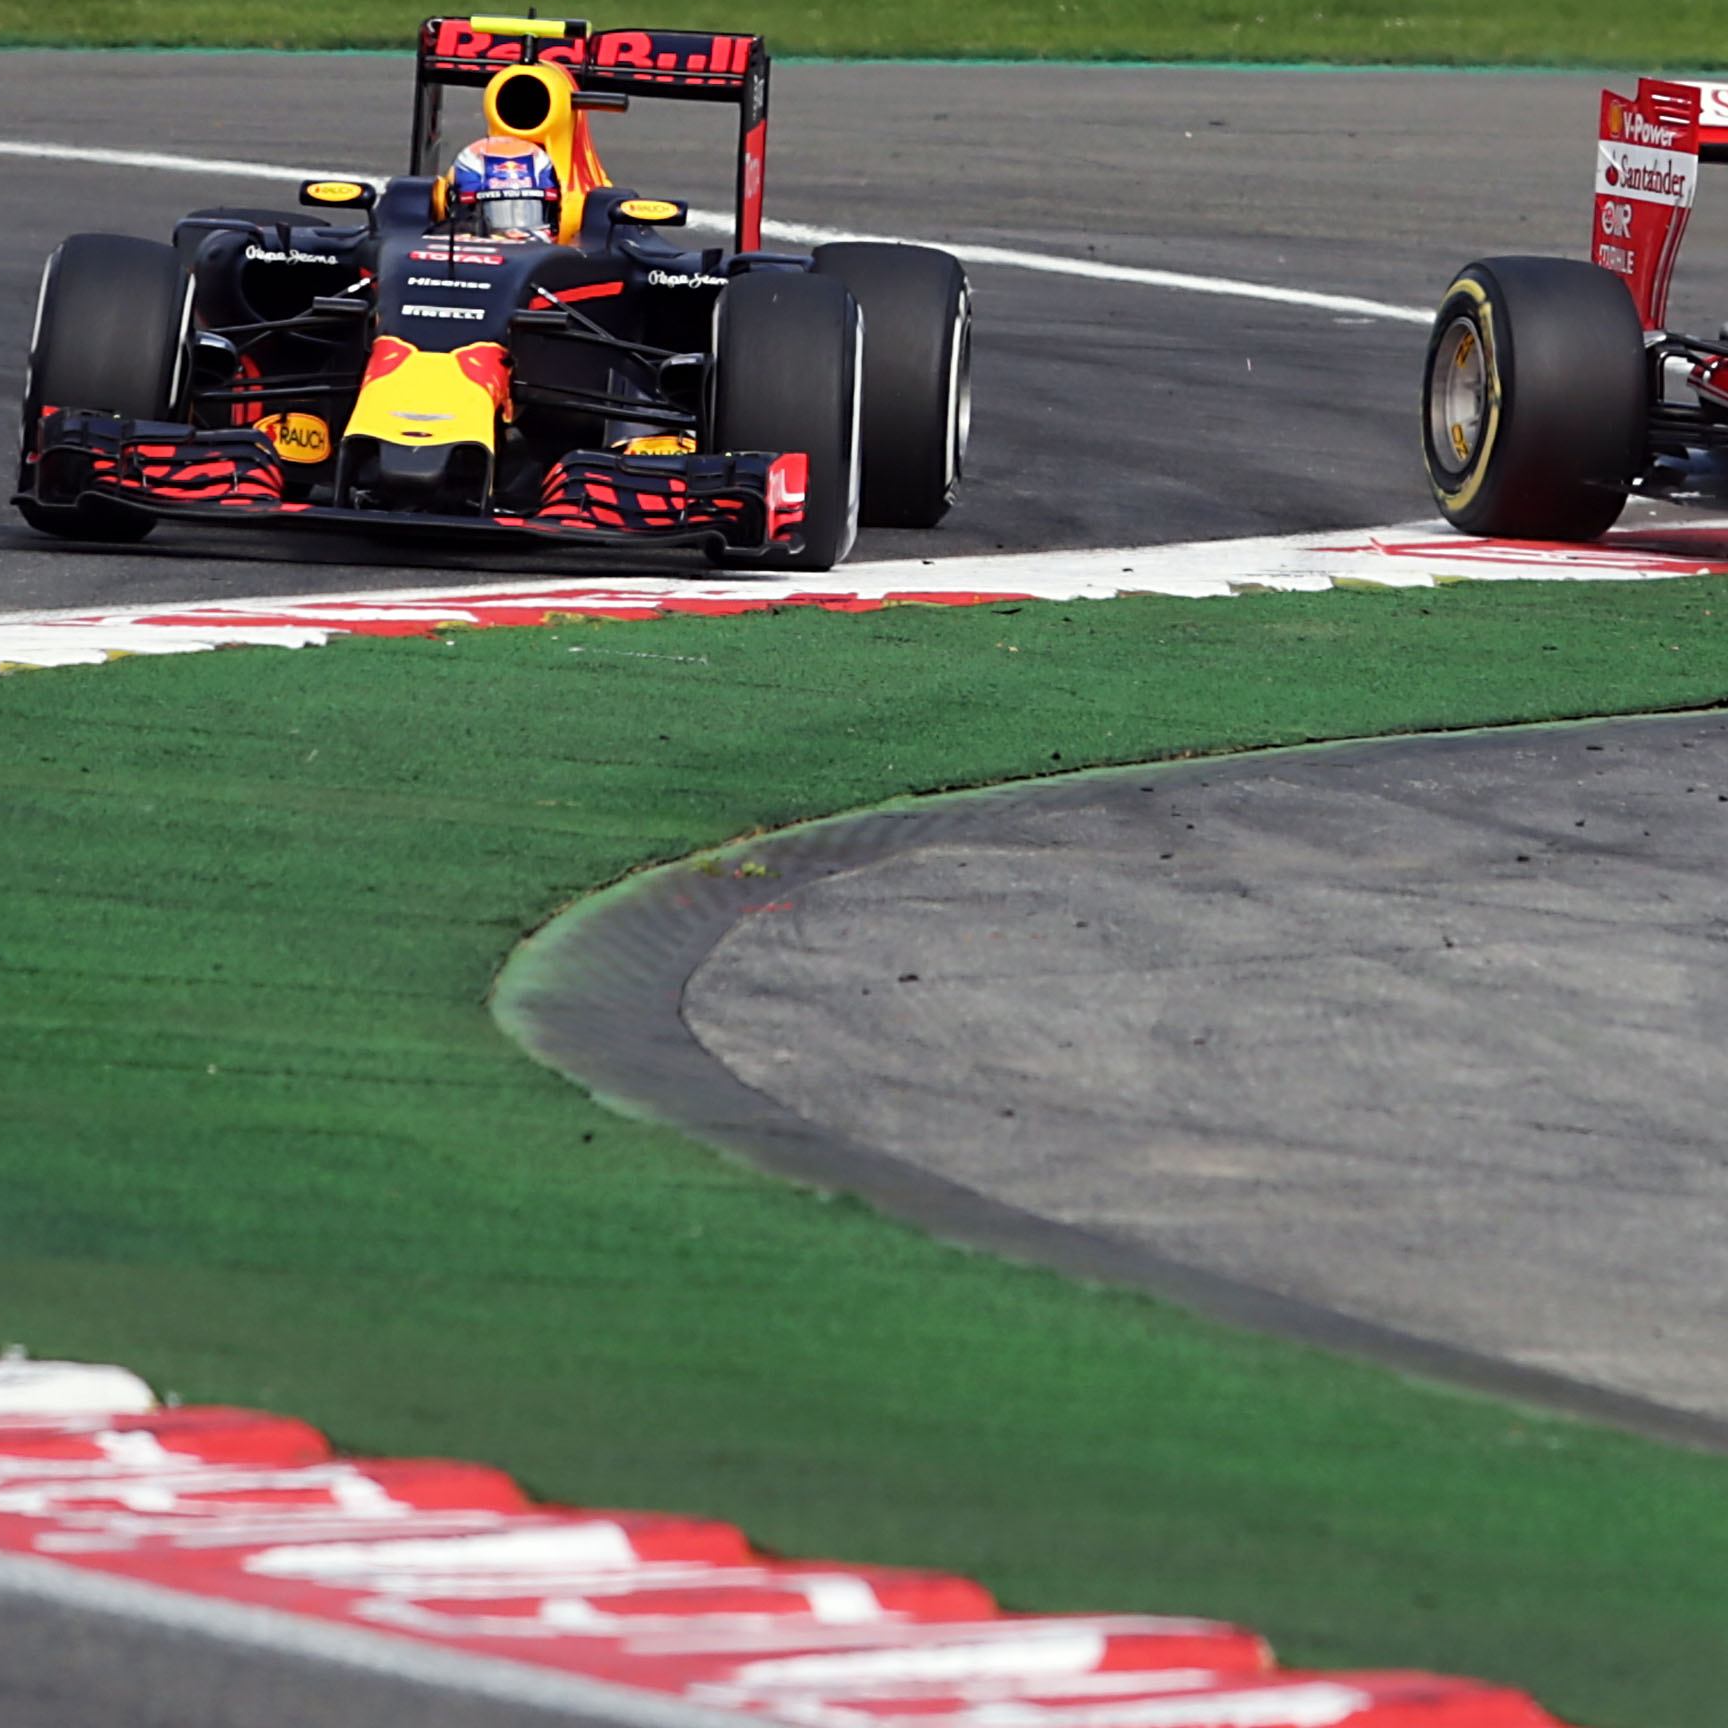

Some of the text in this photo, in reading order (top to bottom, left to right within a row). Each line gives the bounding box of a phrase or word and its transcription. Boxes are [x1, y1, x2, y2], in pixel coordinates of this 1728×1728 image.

[596, 31, 754, 86] Bull
[1619, 153, 1686, 199] Santander
[415, 251, 502, 265] TOTAL
[407, 276, 491, 290] Hisense
[401, 304, 485, 320] PIRELLI
[279, 425, 326, 452] RAUCH
